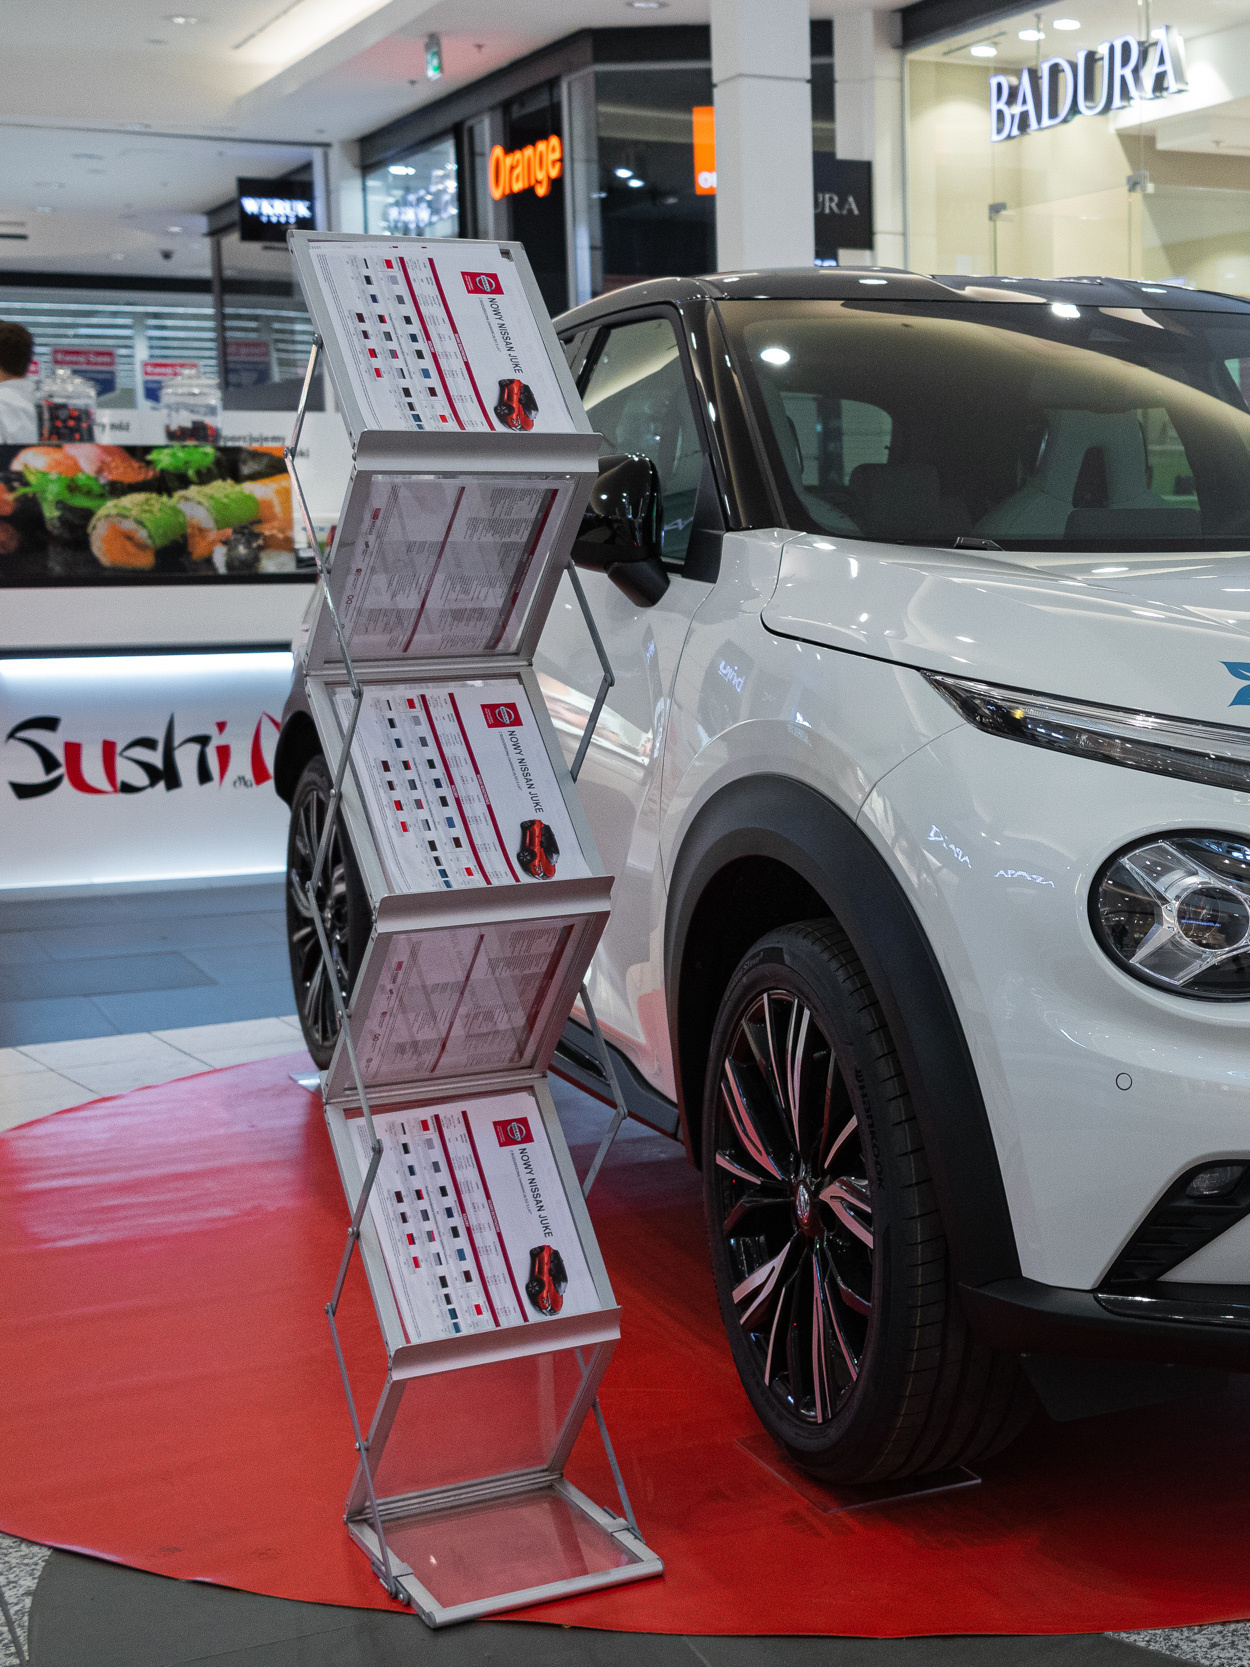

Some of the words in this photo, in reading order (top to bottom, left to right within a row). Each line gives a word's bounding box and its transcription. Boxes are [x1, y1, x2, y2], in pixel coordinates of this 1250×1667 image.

[989, 25, 1180, 143] BADURA
[488, 134, 564, 201] Orange
[488, 297, 505, 322] NOWY
[497, 322, 516, 353] NISSAN
[508, 353, 524, 375] JUKE
[5, 712, 232, 800] Sushi
[507, 730, 524, 756] NOWY
[517, 758, 536, 790] NISSAN
[529, 791, 544, 814] JUKE
[519, 1147, 535, 1175] NOWY
[527, 1177, 546, 1212] NISSAN
[538, 1214, 554, 1238] JUKE
